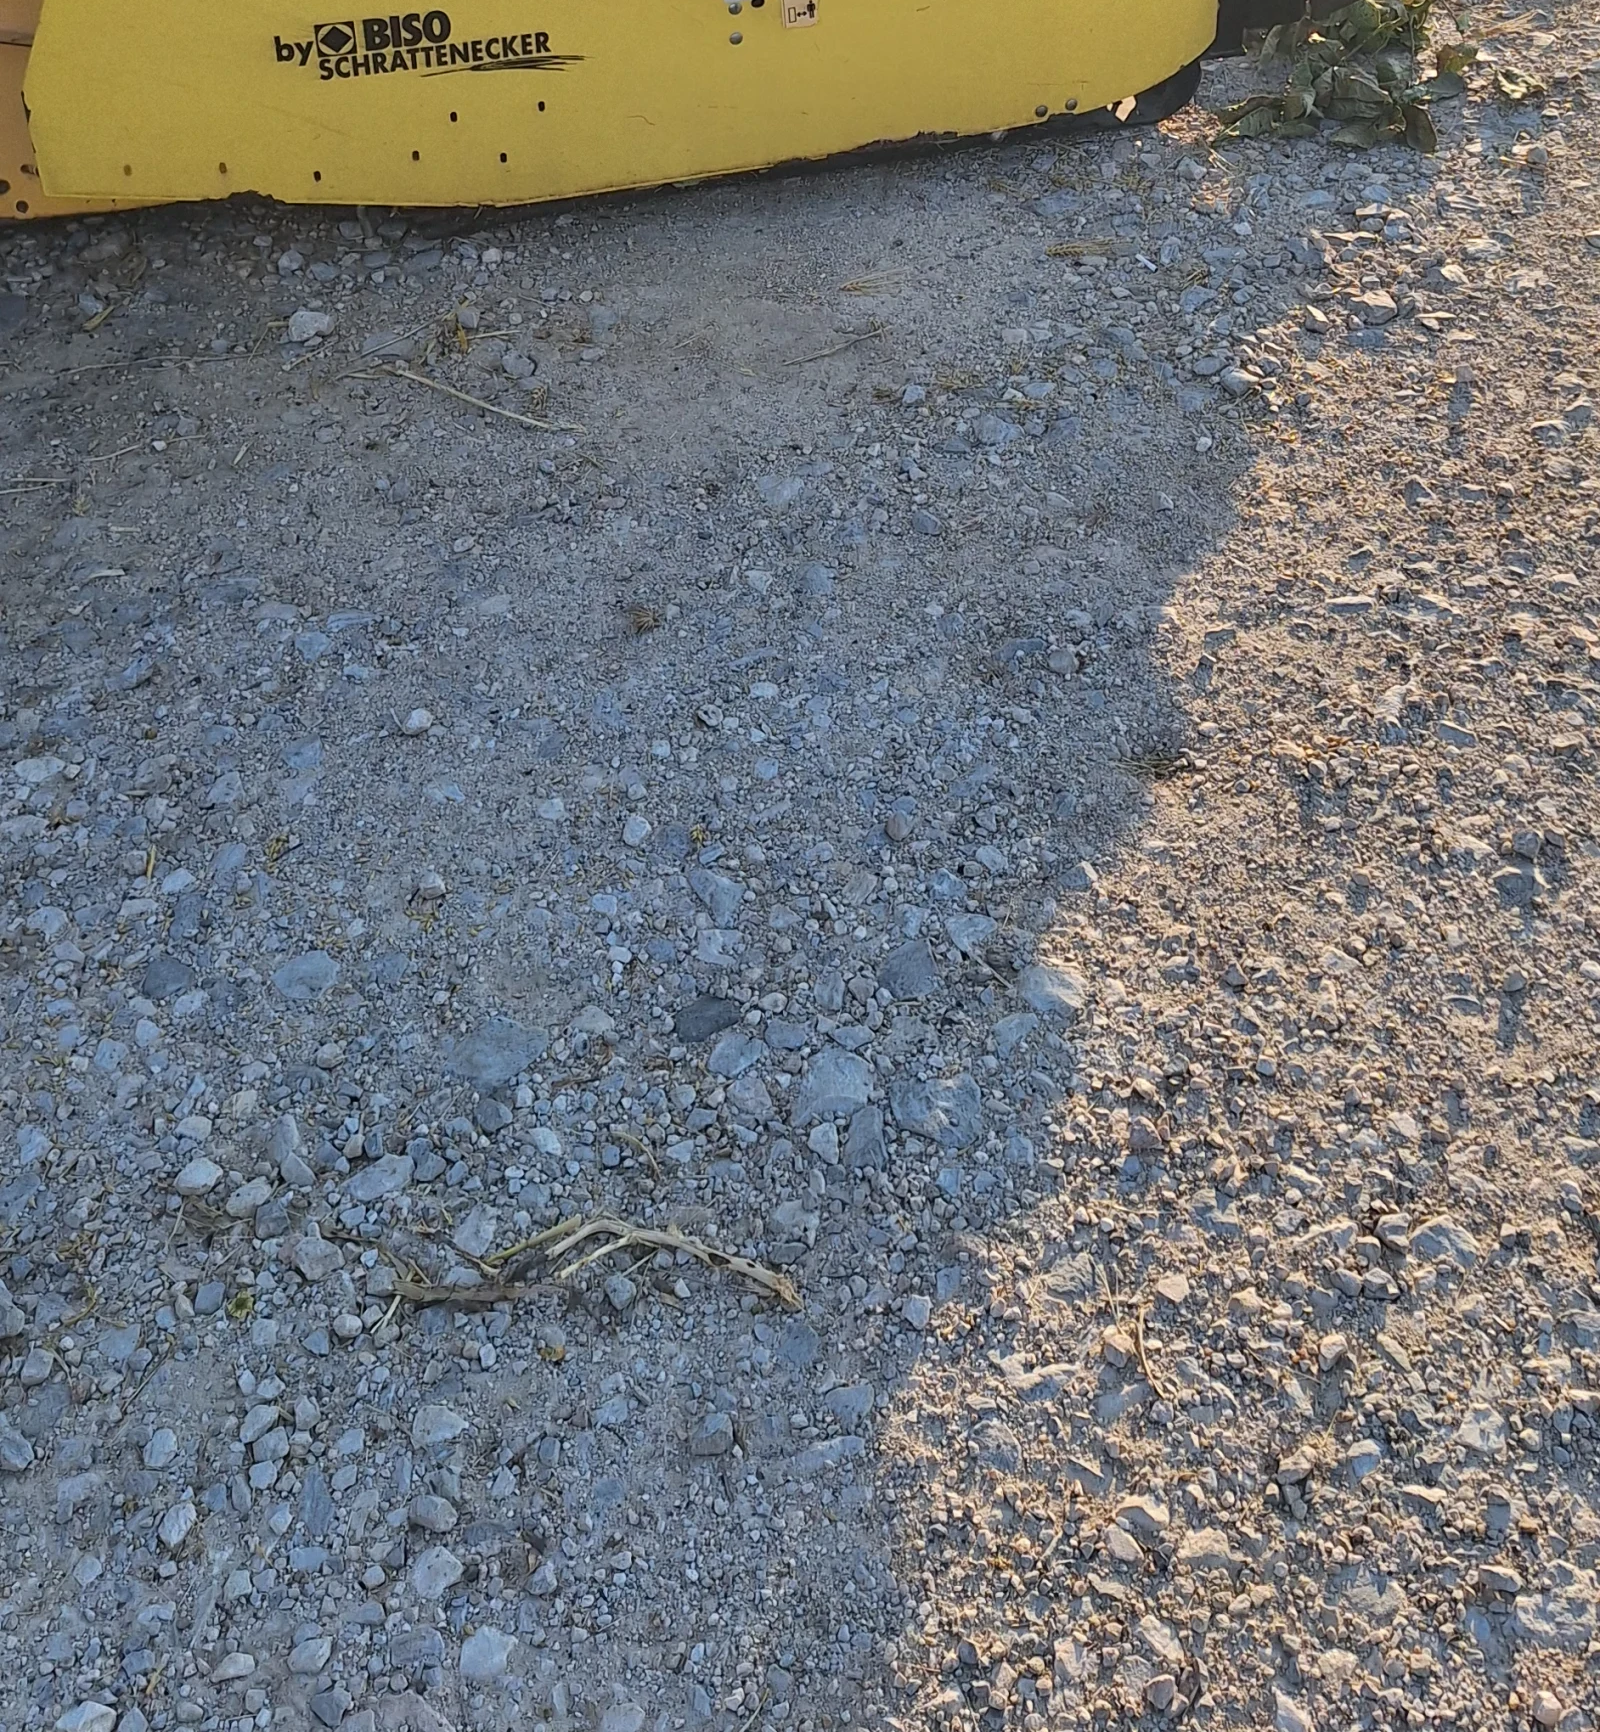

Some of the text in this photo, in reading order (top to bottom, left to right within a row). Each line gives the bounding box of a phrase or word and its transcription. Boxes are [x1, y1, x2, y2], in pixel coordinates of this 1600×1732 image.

[274, 10, 450, 66] by BISO
[320, 32, 552, 80] SCHRATTENECKER
